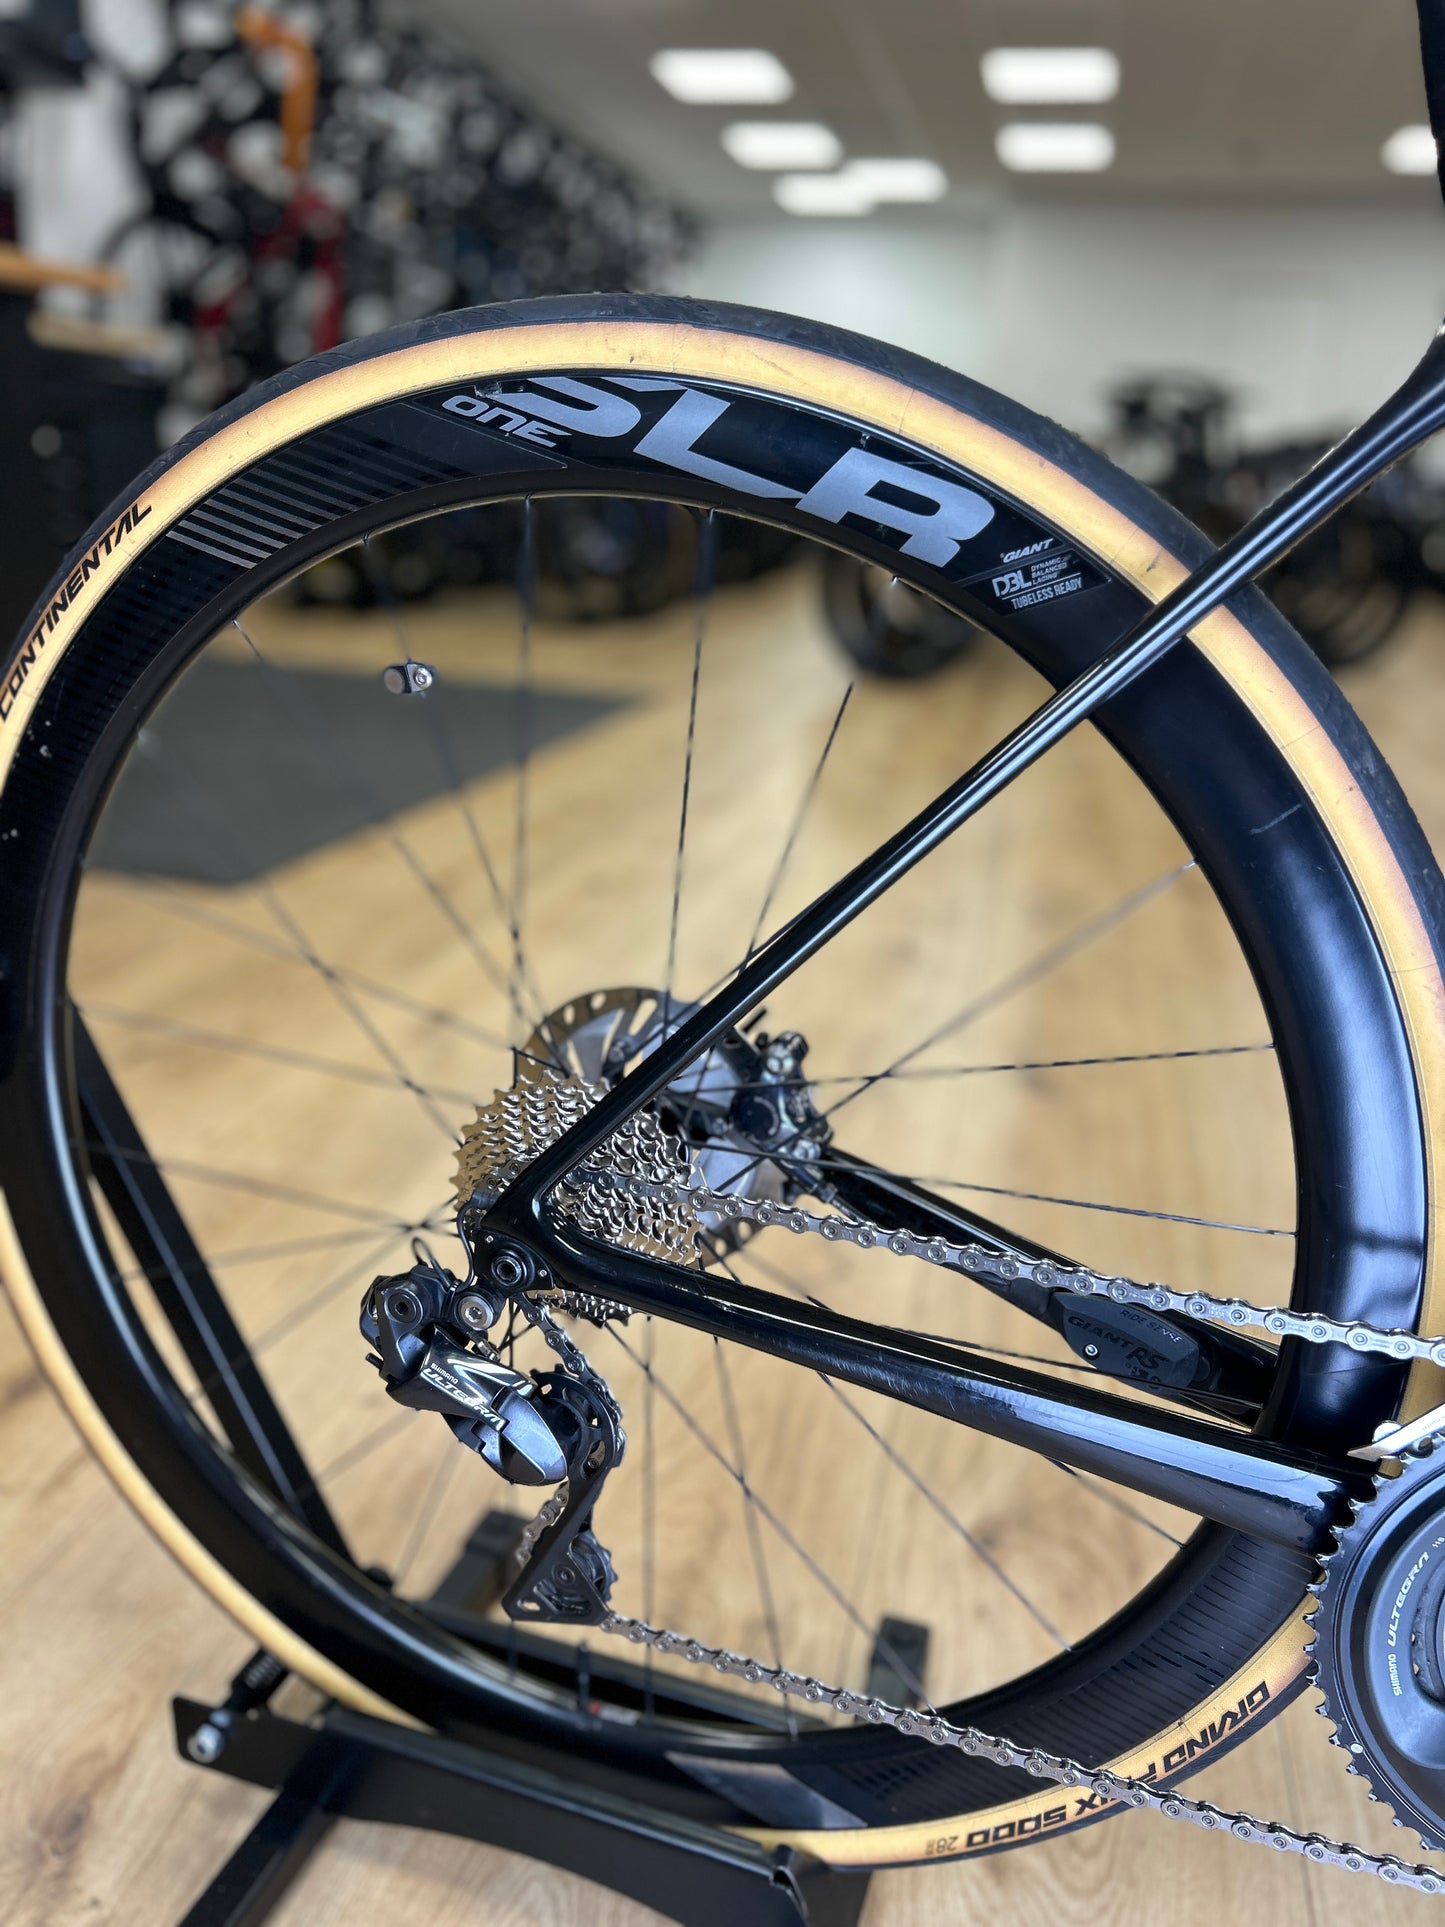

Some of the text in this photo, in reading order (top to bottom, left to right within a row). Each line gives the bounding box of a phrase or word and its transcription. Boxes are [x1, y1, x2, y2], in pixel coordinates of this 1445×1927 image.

[483, 377, 995, 568] SLR
[1003, 538, 1054, 563] GIANT
[1031, 556, 1062, 572] DYNAMIC
[1031, 562, 1068, 579] BALANCED
[1032, 572, 1058, 585] LACING
[1011, 576, 1082, 610] TUBELESS READY
[0, 503, 152, 723] CONTINENTAL
[1067, 1315, 1134, 1348] GIANT
[1120, 1310, 1183, 1343] RIDE SENSE
[430, 1362, 459, 1385] SHIMANO
[1387, 1551, 1429, 1648] ULTEGRA
[1387, 1653, 1403, 1697] SHIMANO
[1163, 1681, 1271, 1773] GRAND
[966, 1804, 1067, 1848] 5000
